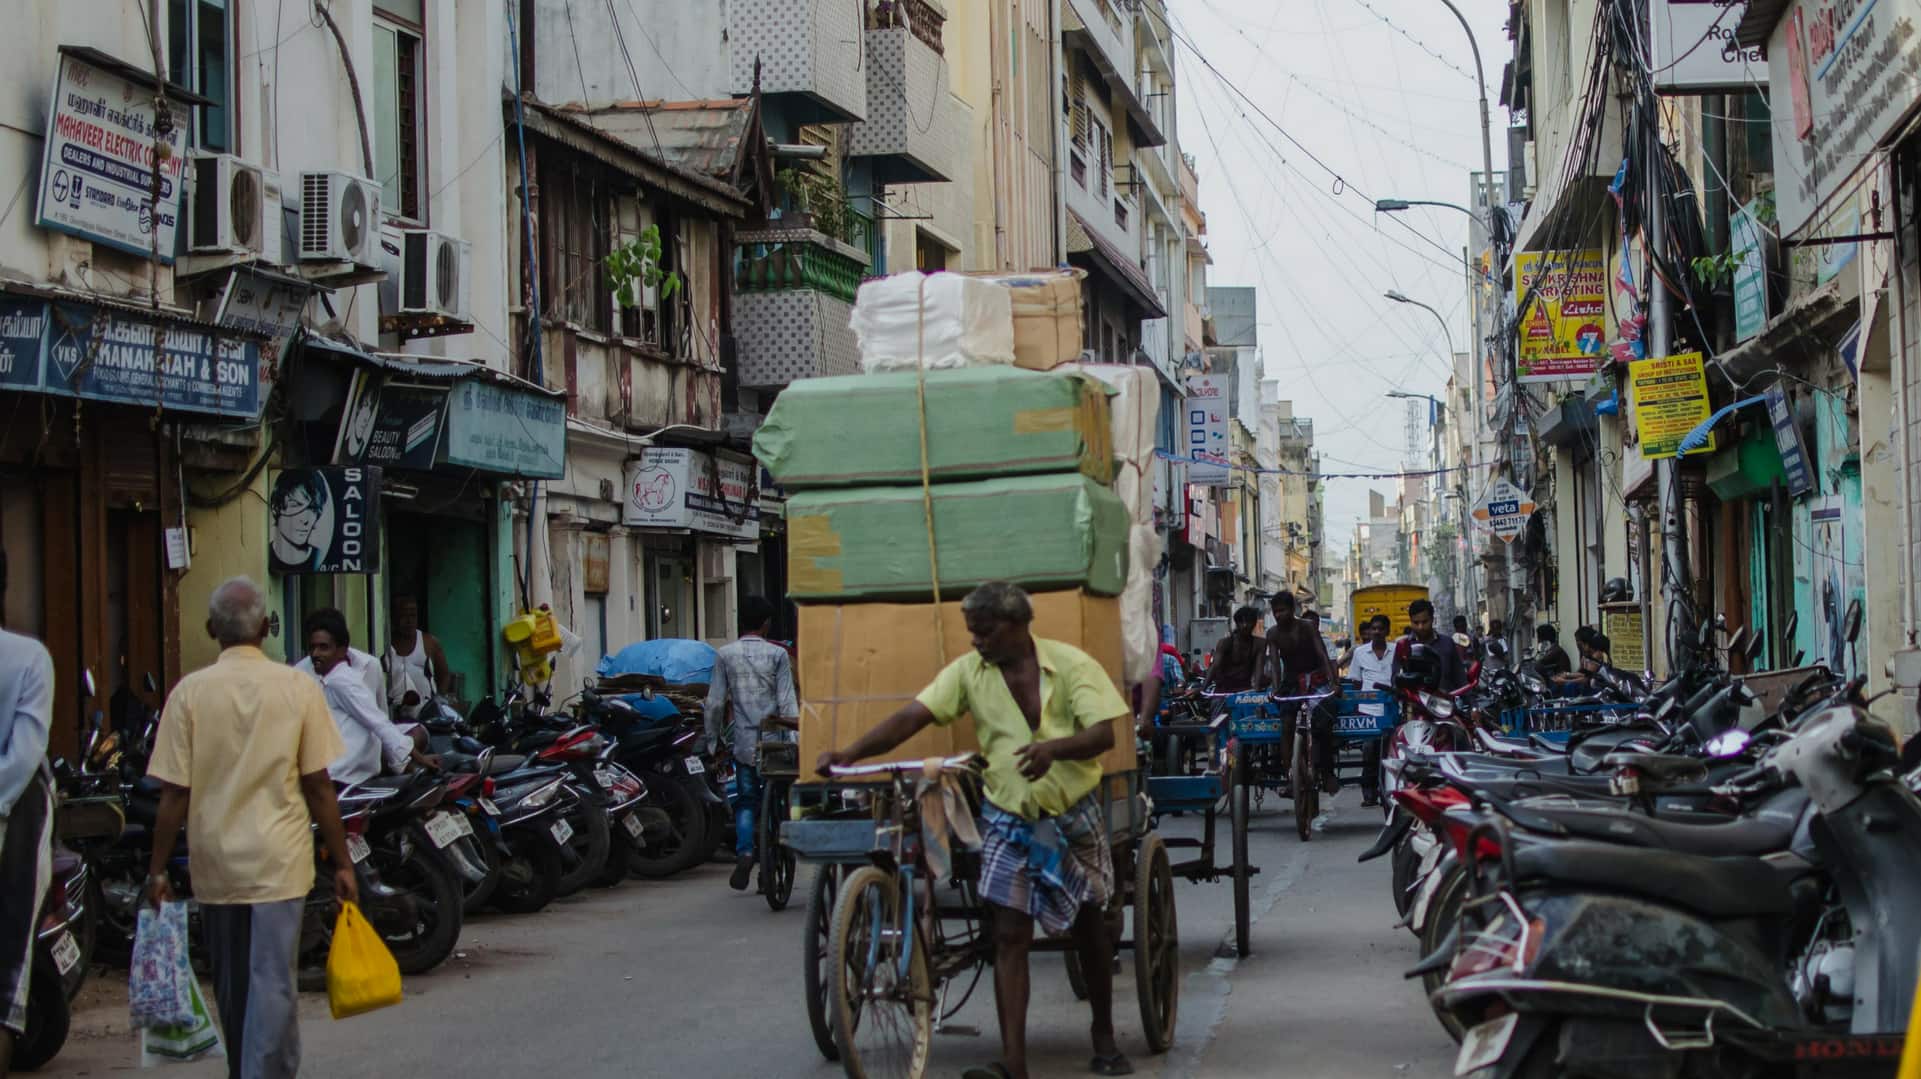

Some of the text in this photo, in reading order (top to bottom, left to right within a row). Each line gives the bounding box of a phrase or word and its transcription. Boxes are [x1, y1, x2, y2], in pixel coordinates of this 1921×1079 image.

[56, 112, 104, 149] MAHAVEER
[105, 131, 143, 163] ELECTRIC
[63, 147, 92, 167] DEALERS
[92, 157, 105, 171] AND
[105, 160, 140, 182] INDUSTRIAL
[57, 345, 78, 362] VKS
[217, 360, 249, 386] SON
[373, 429, 400, 445] BEAUTY
[368, 445, 395, 459] SALOON
[342, 468, 362, 571] SALOON
[1491, 503, 1516, 515] veta
